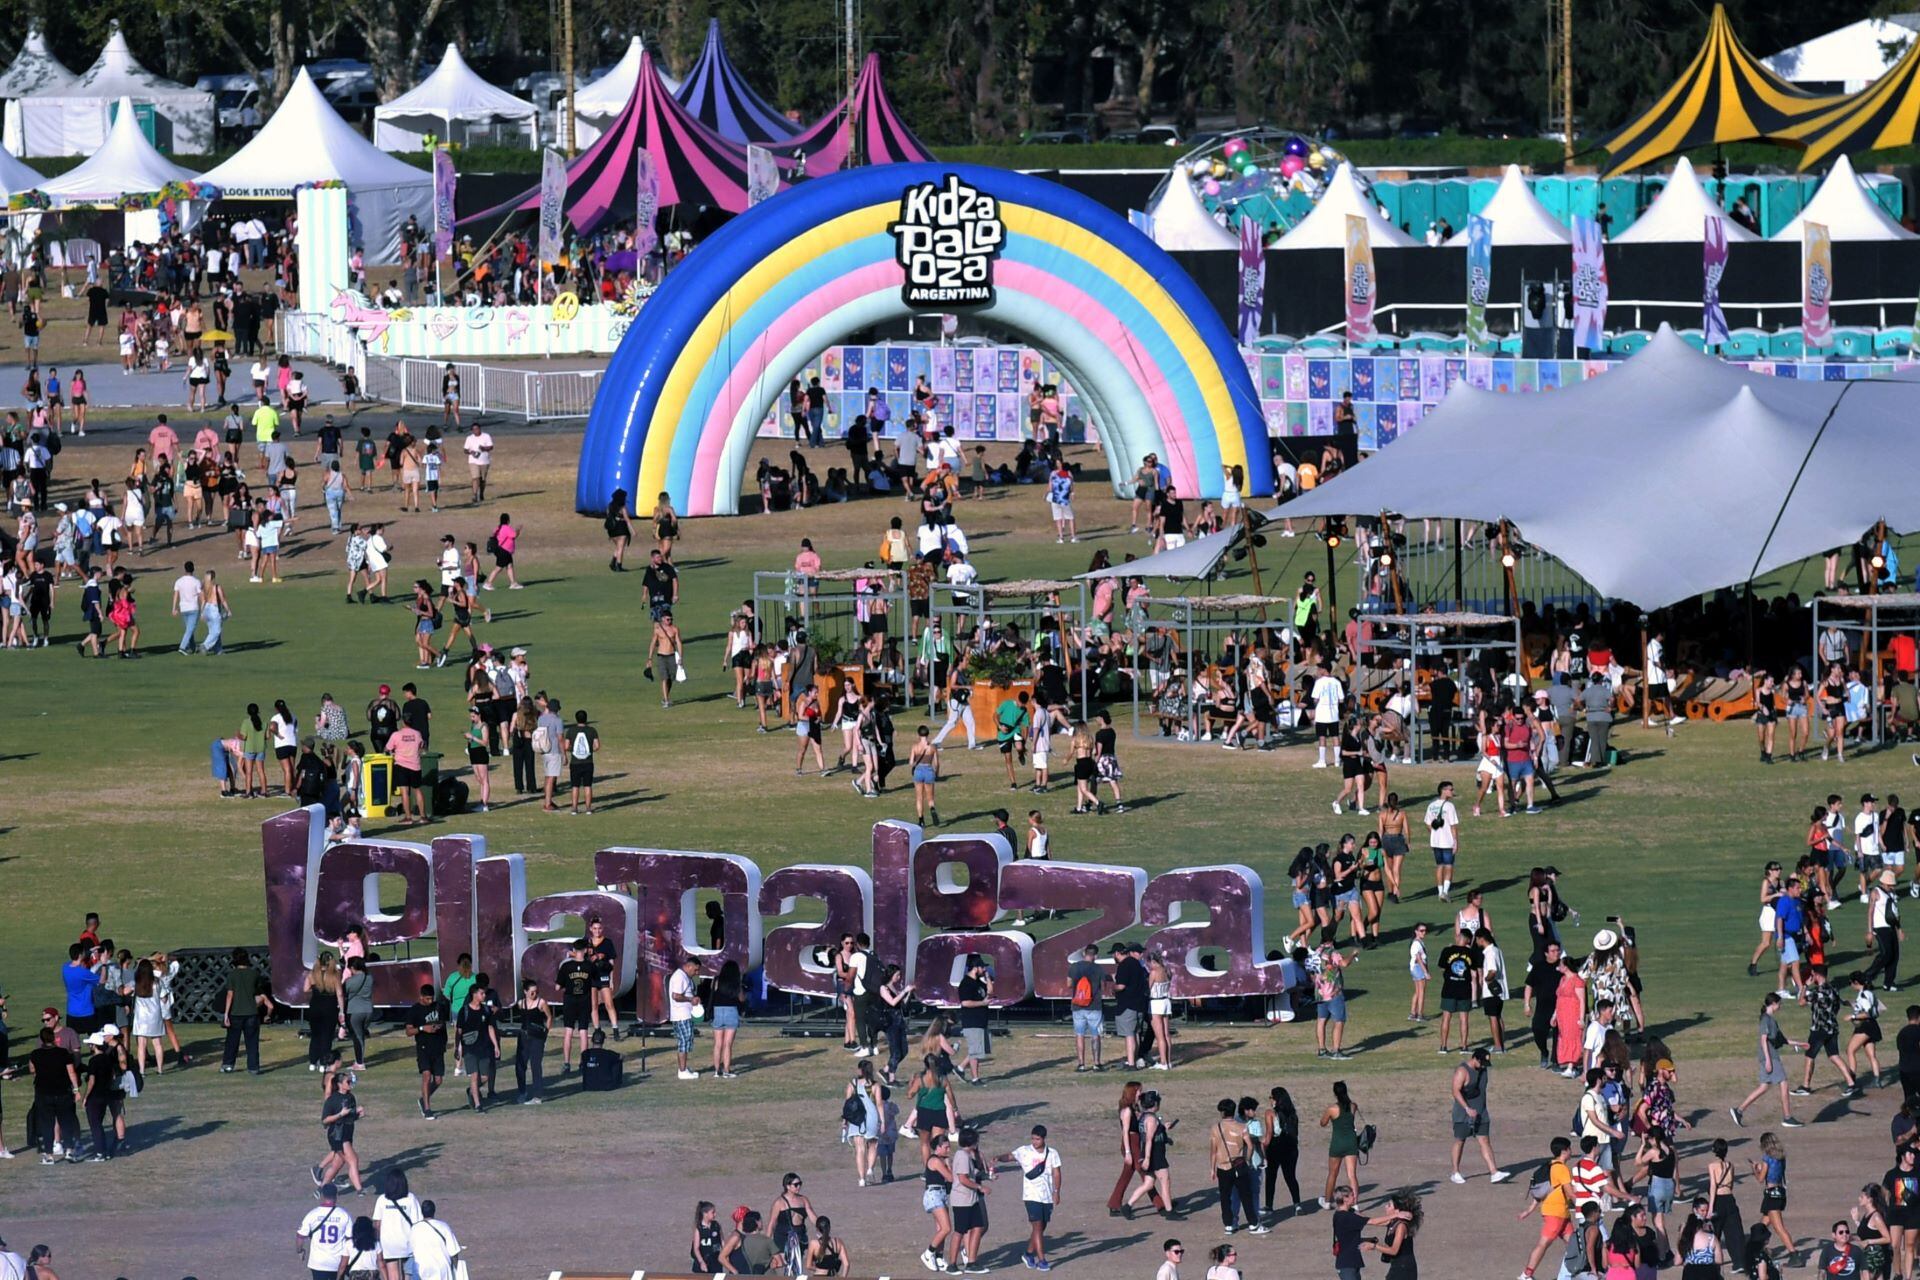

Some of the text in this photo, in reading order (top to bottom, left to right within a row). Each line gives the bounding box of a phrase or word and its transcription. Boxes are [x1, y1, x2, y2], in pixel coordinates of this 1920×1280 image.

[223, 188, 250, 196] LOOK
[909, 286, 990, 301] ARGENTINA
[318, 1224, 339, 1244] 19
